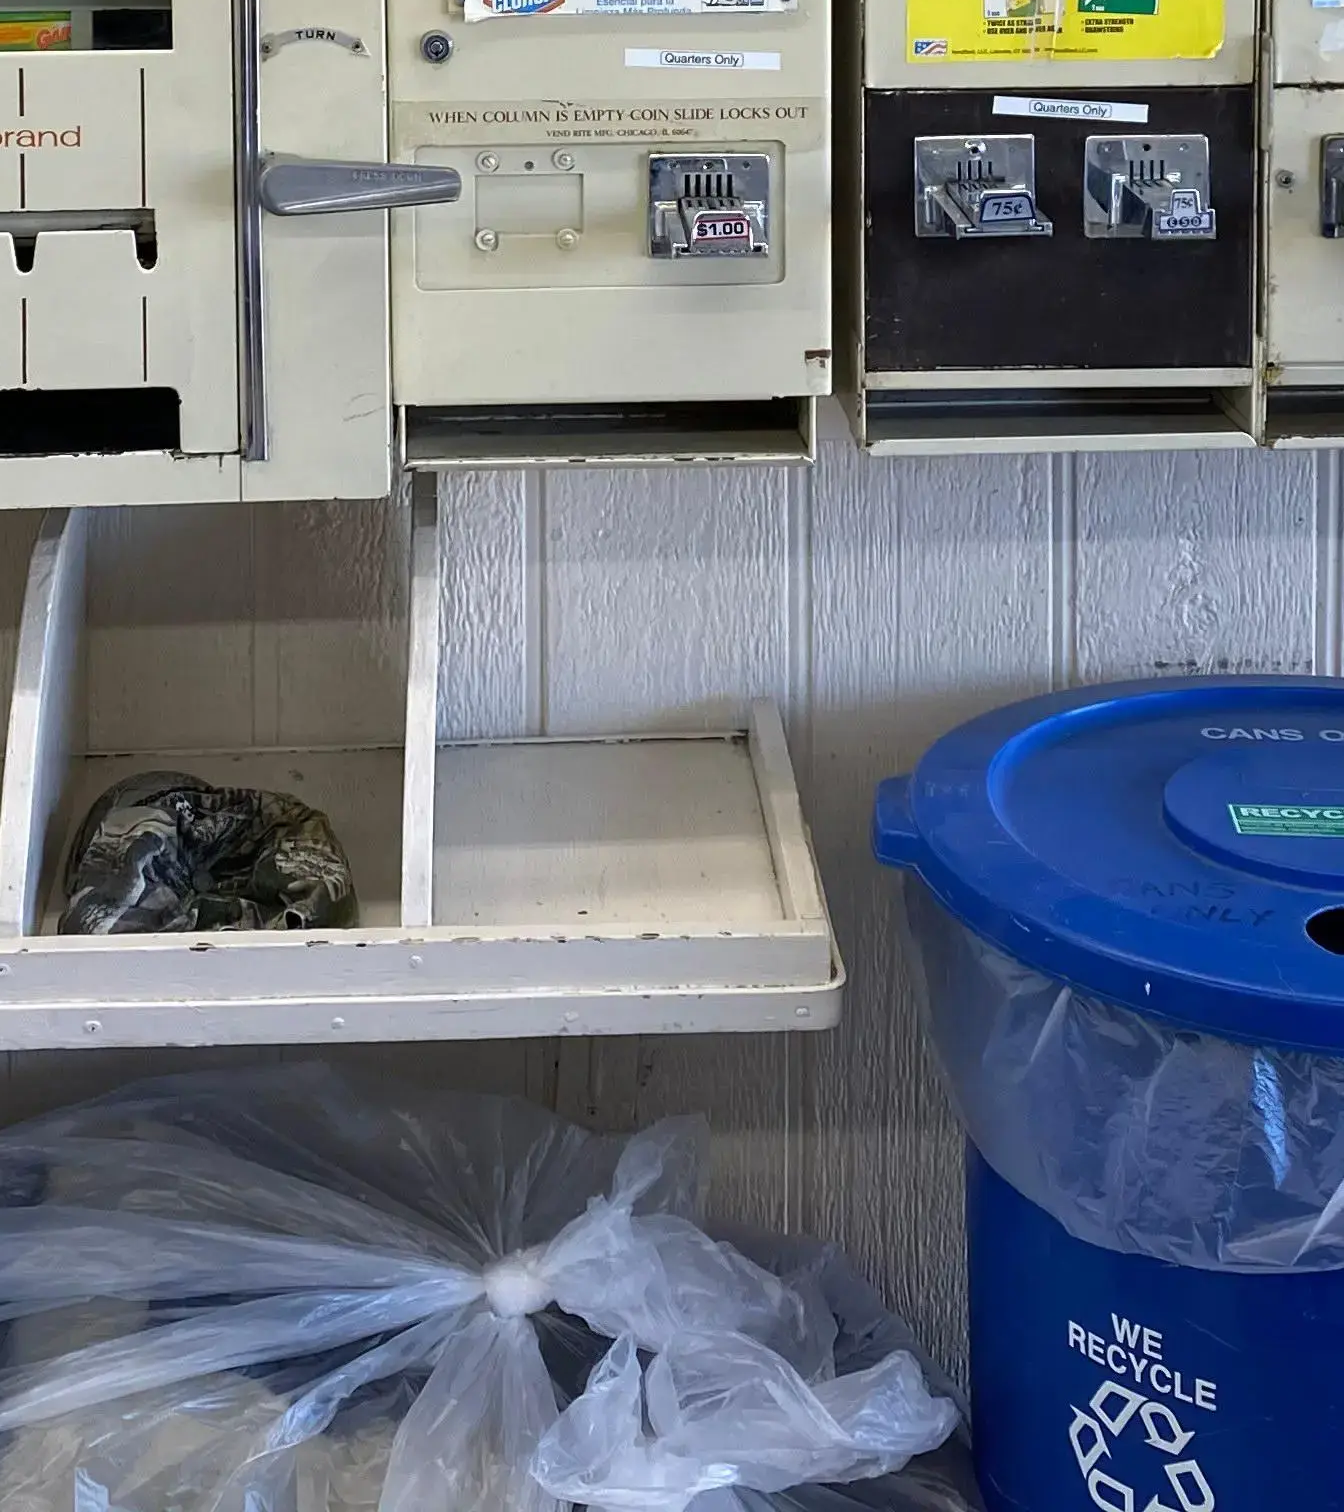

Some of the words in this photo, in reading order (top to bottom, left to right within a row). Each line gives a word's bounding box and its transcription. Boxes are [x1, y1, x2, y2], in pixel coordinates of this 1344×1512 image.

[295, 30, 338, 41] TURN
[664, 52, 712, 66] Quarters
[714, 54, 740, 67] Only
[429, 111, 478, 125] WHEN
[482, 110, 550, 124] COLUMN
[555, 109, 569, 122] IS
[573, 108, 624, 122] EMPTY
[629, 108, 670, 122] COIN
[674, 107, 715, 121] SLIDE
[720, 106, 771, 120] LOCKS
[774, 106, 809, 120] OUT
[1034, 101, 1080, 116] Quarters
[1082, 104, 1108, 118] Only
[992, 200, 1024, 216] 75¢
[696, 222, 745, 236] $1.00
[1200, 727, 1304, 741] CANS
[1111, 1312, 1163, 1360] WE
[1068, 1320, 1217, 1411] RECYCLE
